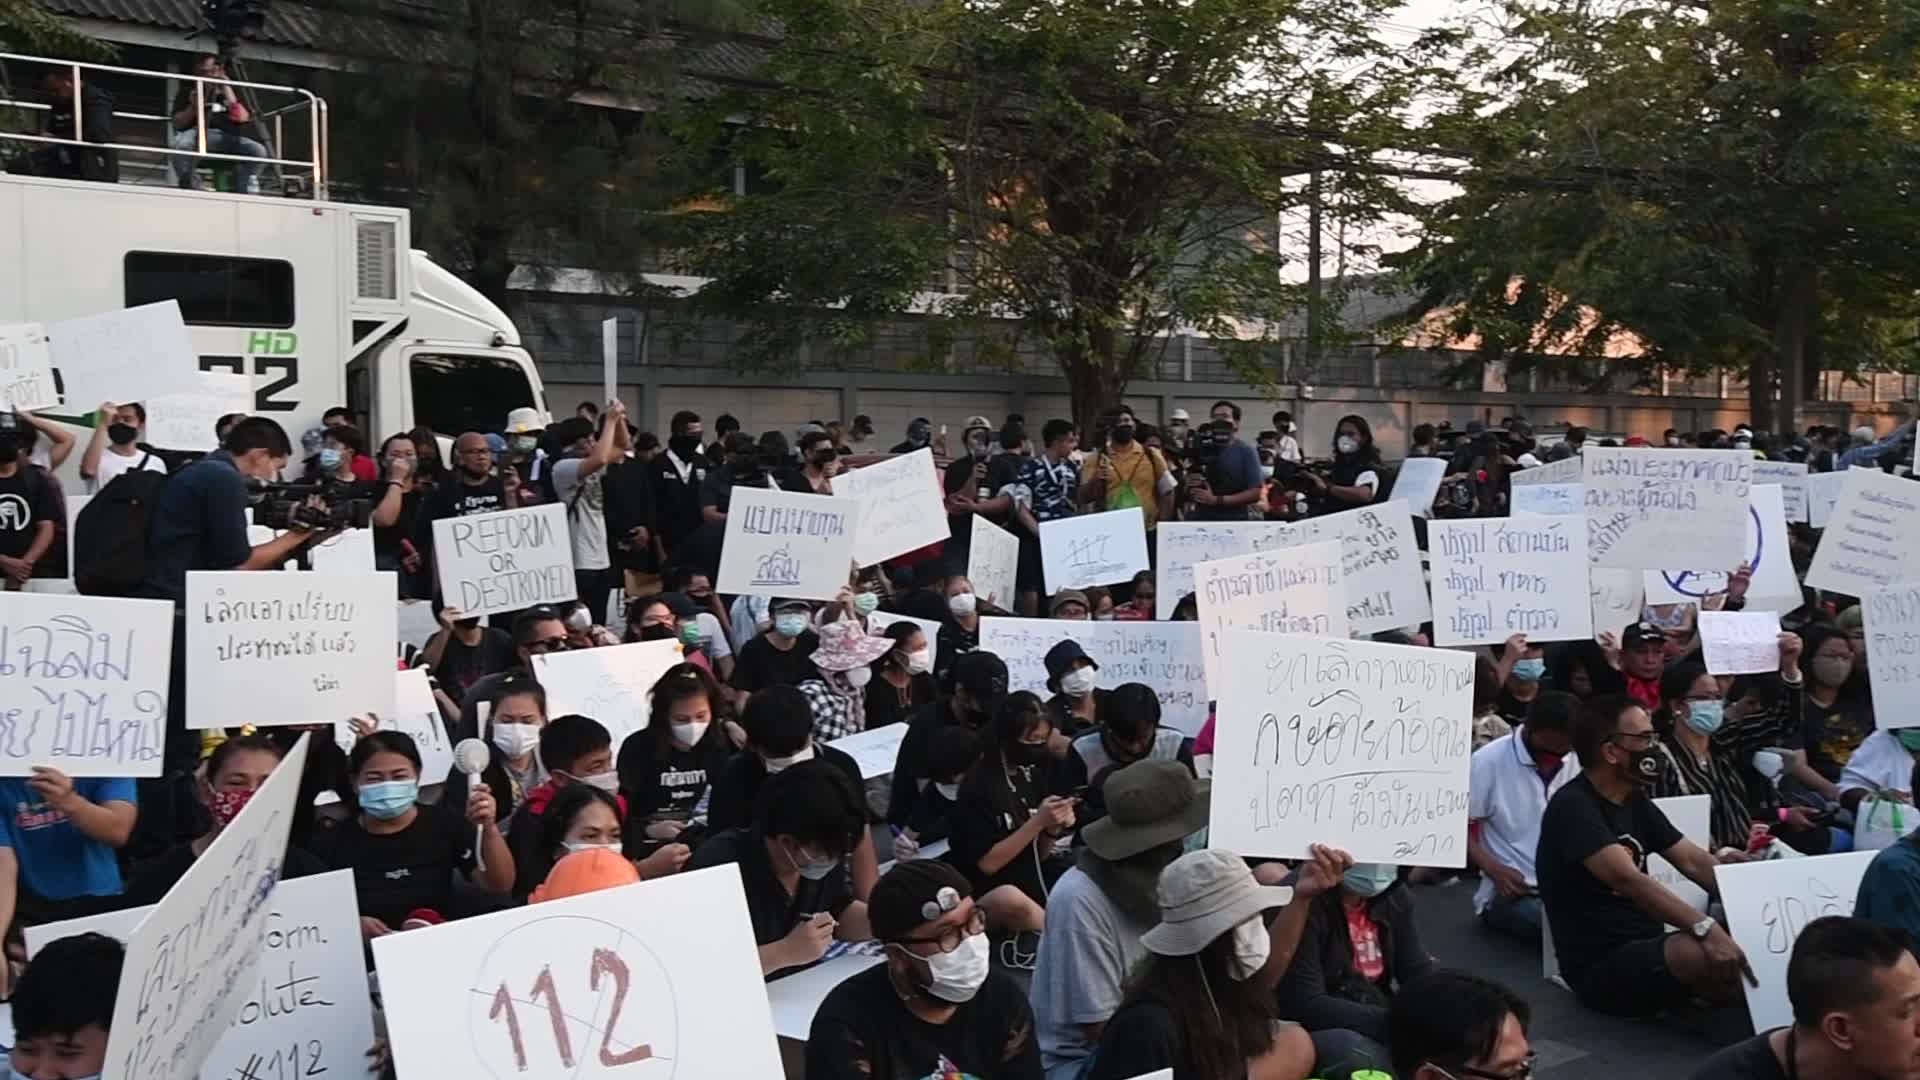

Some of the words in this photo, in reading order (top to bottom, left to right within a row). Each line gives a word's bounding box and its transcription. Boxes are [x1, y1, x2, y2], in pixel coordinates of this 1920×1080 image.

[248, 331, 297, 355] HD
[452, 513, 554, 558] REFORM
[489, 552, 517, 573] OR
[460, 564, 573, 613] DESTROYED
[489, 946, 653, 1072] 112
